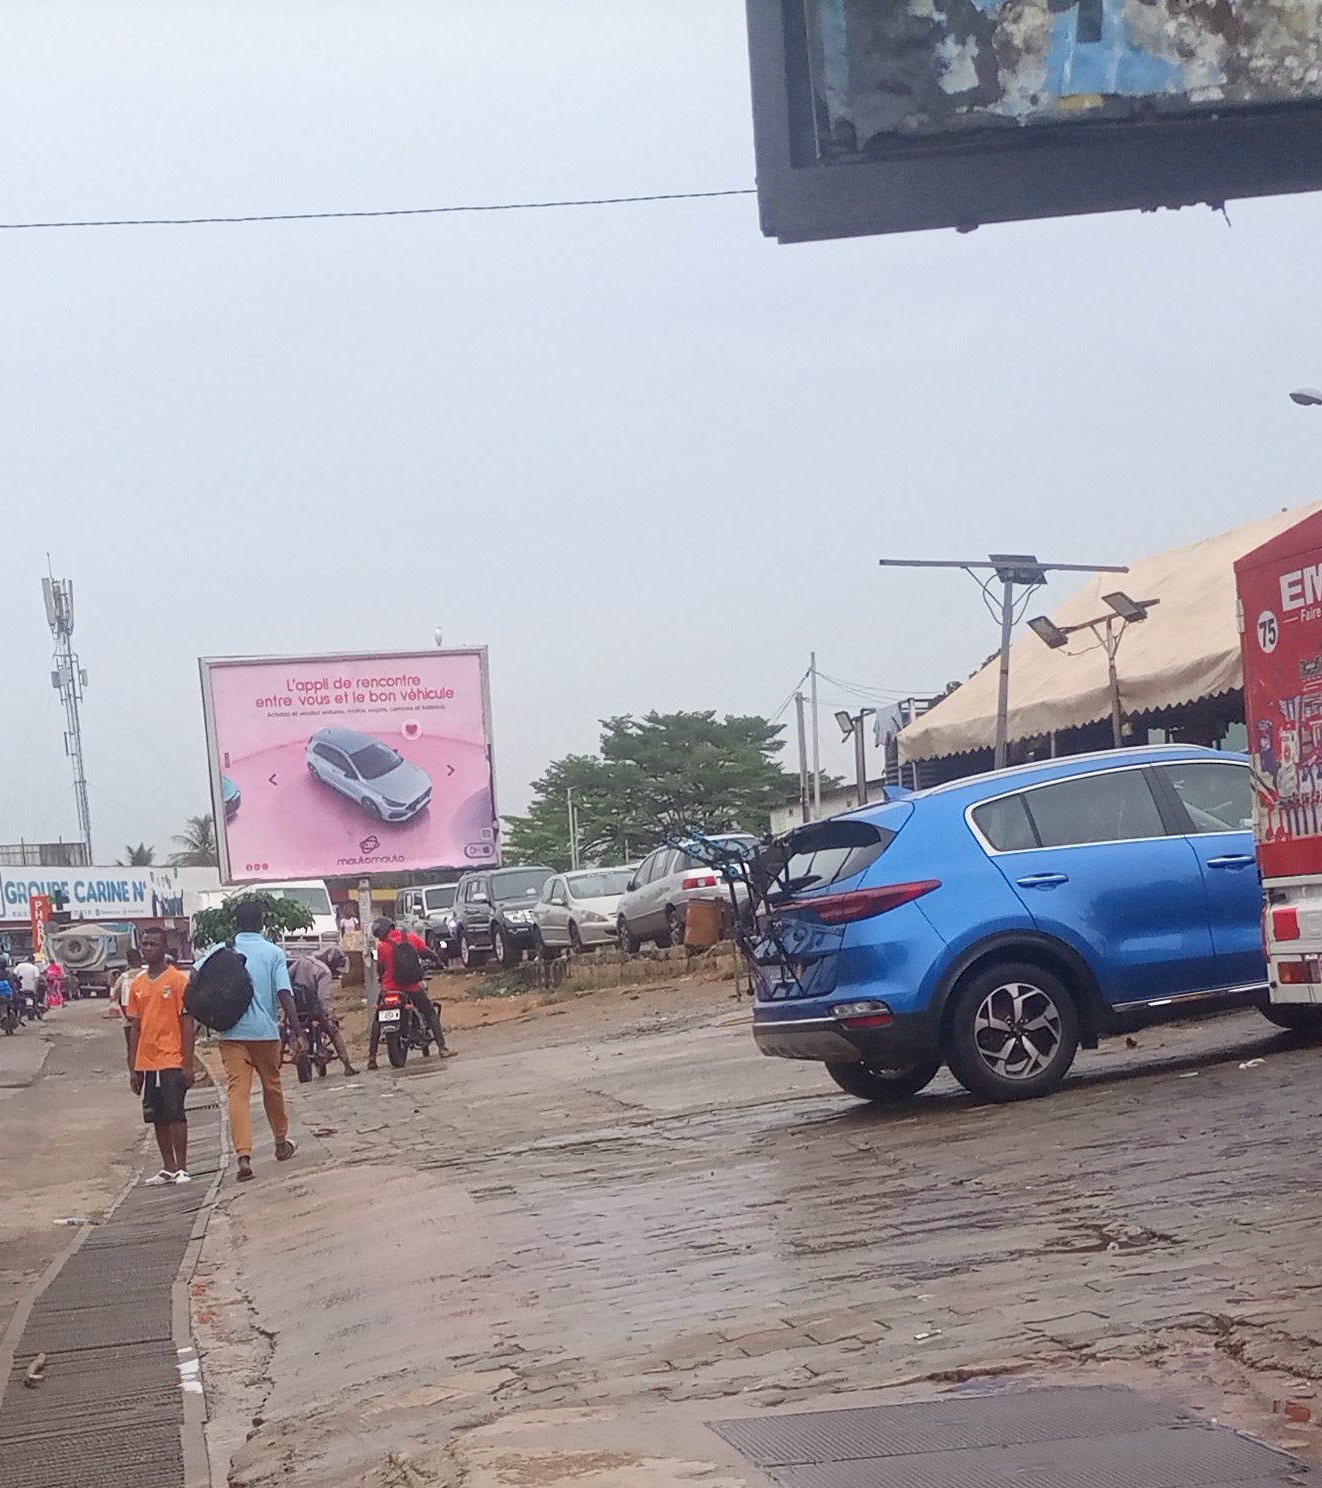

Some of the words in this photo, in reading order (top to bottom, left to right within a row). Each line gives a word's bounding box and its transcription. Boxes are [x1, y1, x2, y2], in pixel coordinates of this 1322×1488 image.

[1300, 605, 1322, 623] Faire
[1259, 618, 1277, 648] 75
[286, 677, 330, 694] L'appli
[333, 677, 352, 690] de
[356, 674, 421, 689] rencontre
[255, 694, 293, 708] entre
[298, 693, 331, 706] vous
[335, 691, 349, 704] et
[352, 691, 365, 703] le
[369, 689, 397, 703] bon
[399, 687, 455, 701] véhicule
[337, 854, 405, 866] mautomauto
[73, 880, 130, 904] CARINE
